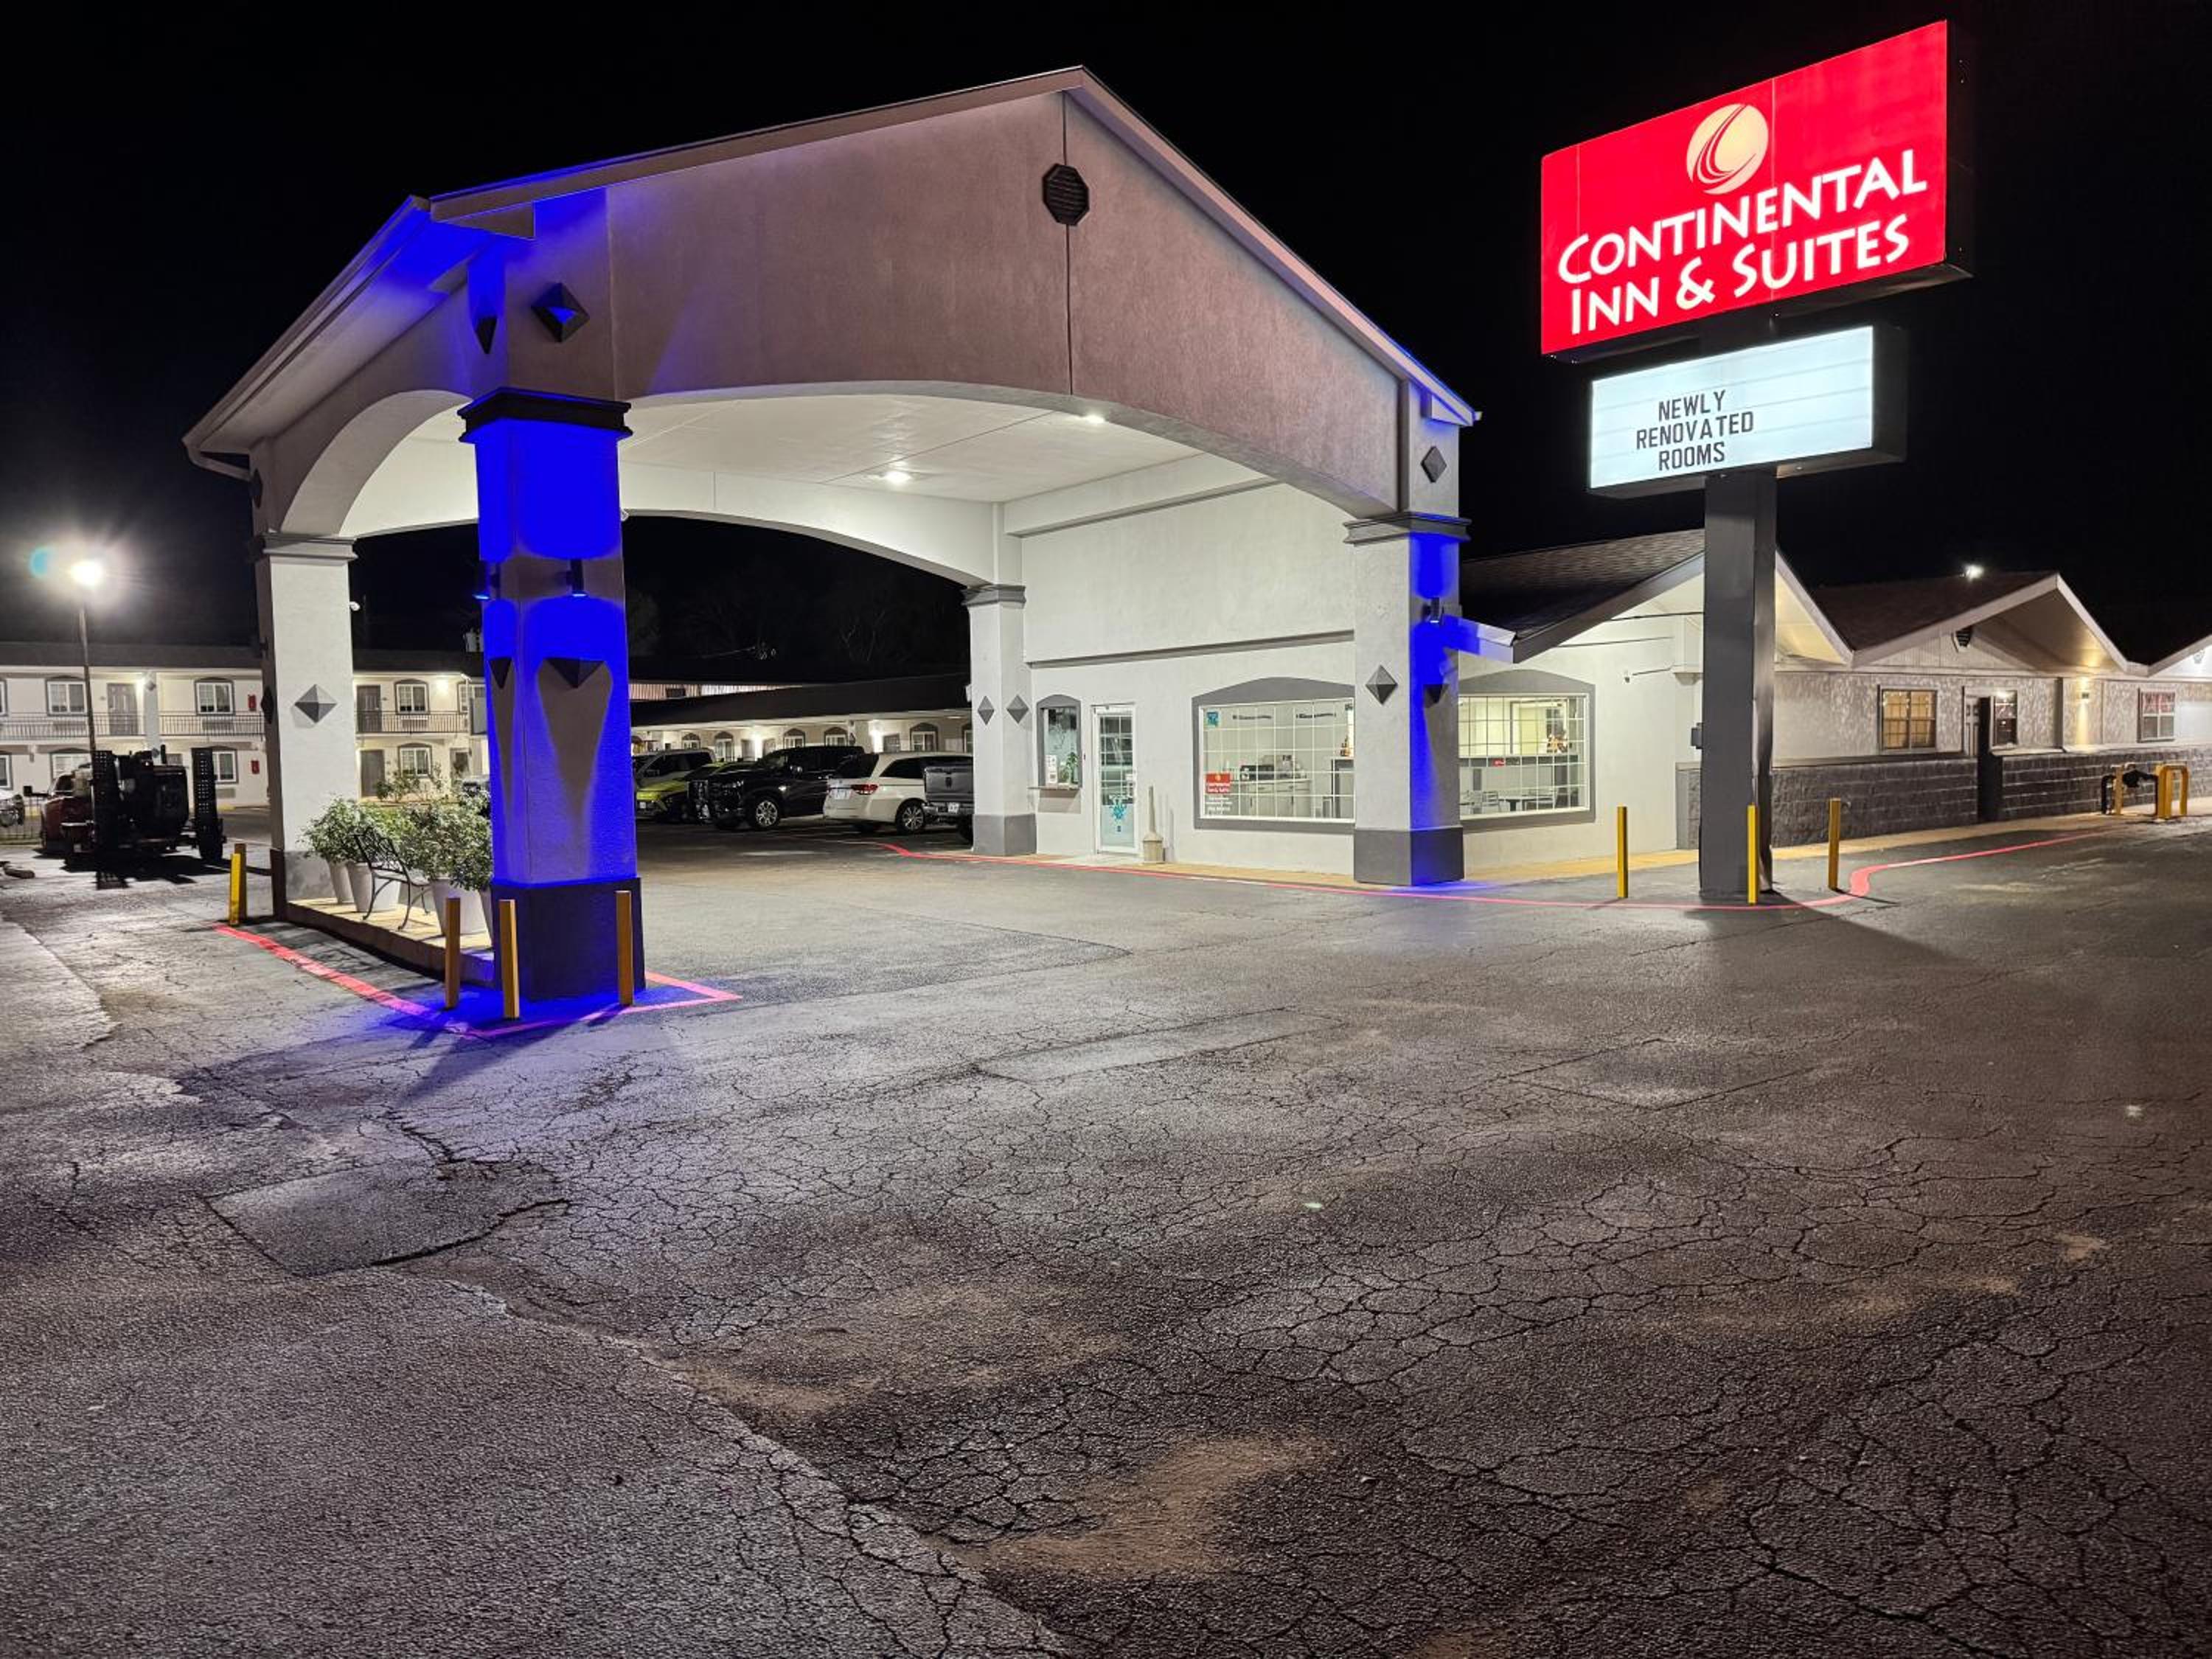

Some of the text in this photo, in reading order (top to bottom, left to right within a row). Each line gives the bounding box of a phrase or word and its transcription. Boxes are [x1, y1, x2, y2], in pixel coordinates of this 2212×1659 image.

[1557, 149, 1927, 284] CONTINENTAL
[1571, 213, 1909, 335] INN & SUITES
[1658, 389, 1726, 422] NEWLY
[1636, 411, 1754, 450] RENOVATED
[1658, 441, 1725, 471] ROOMS
